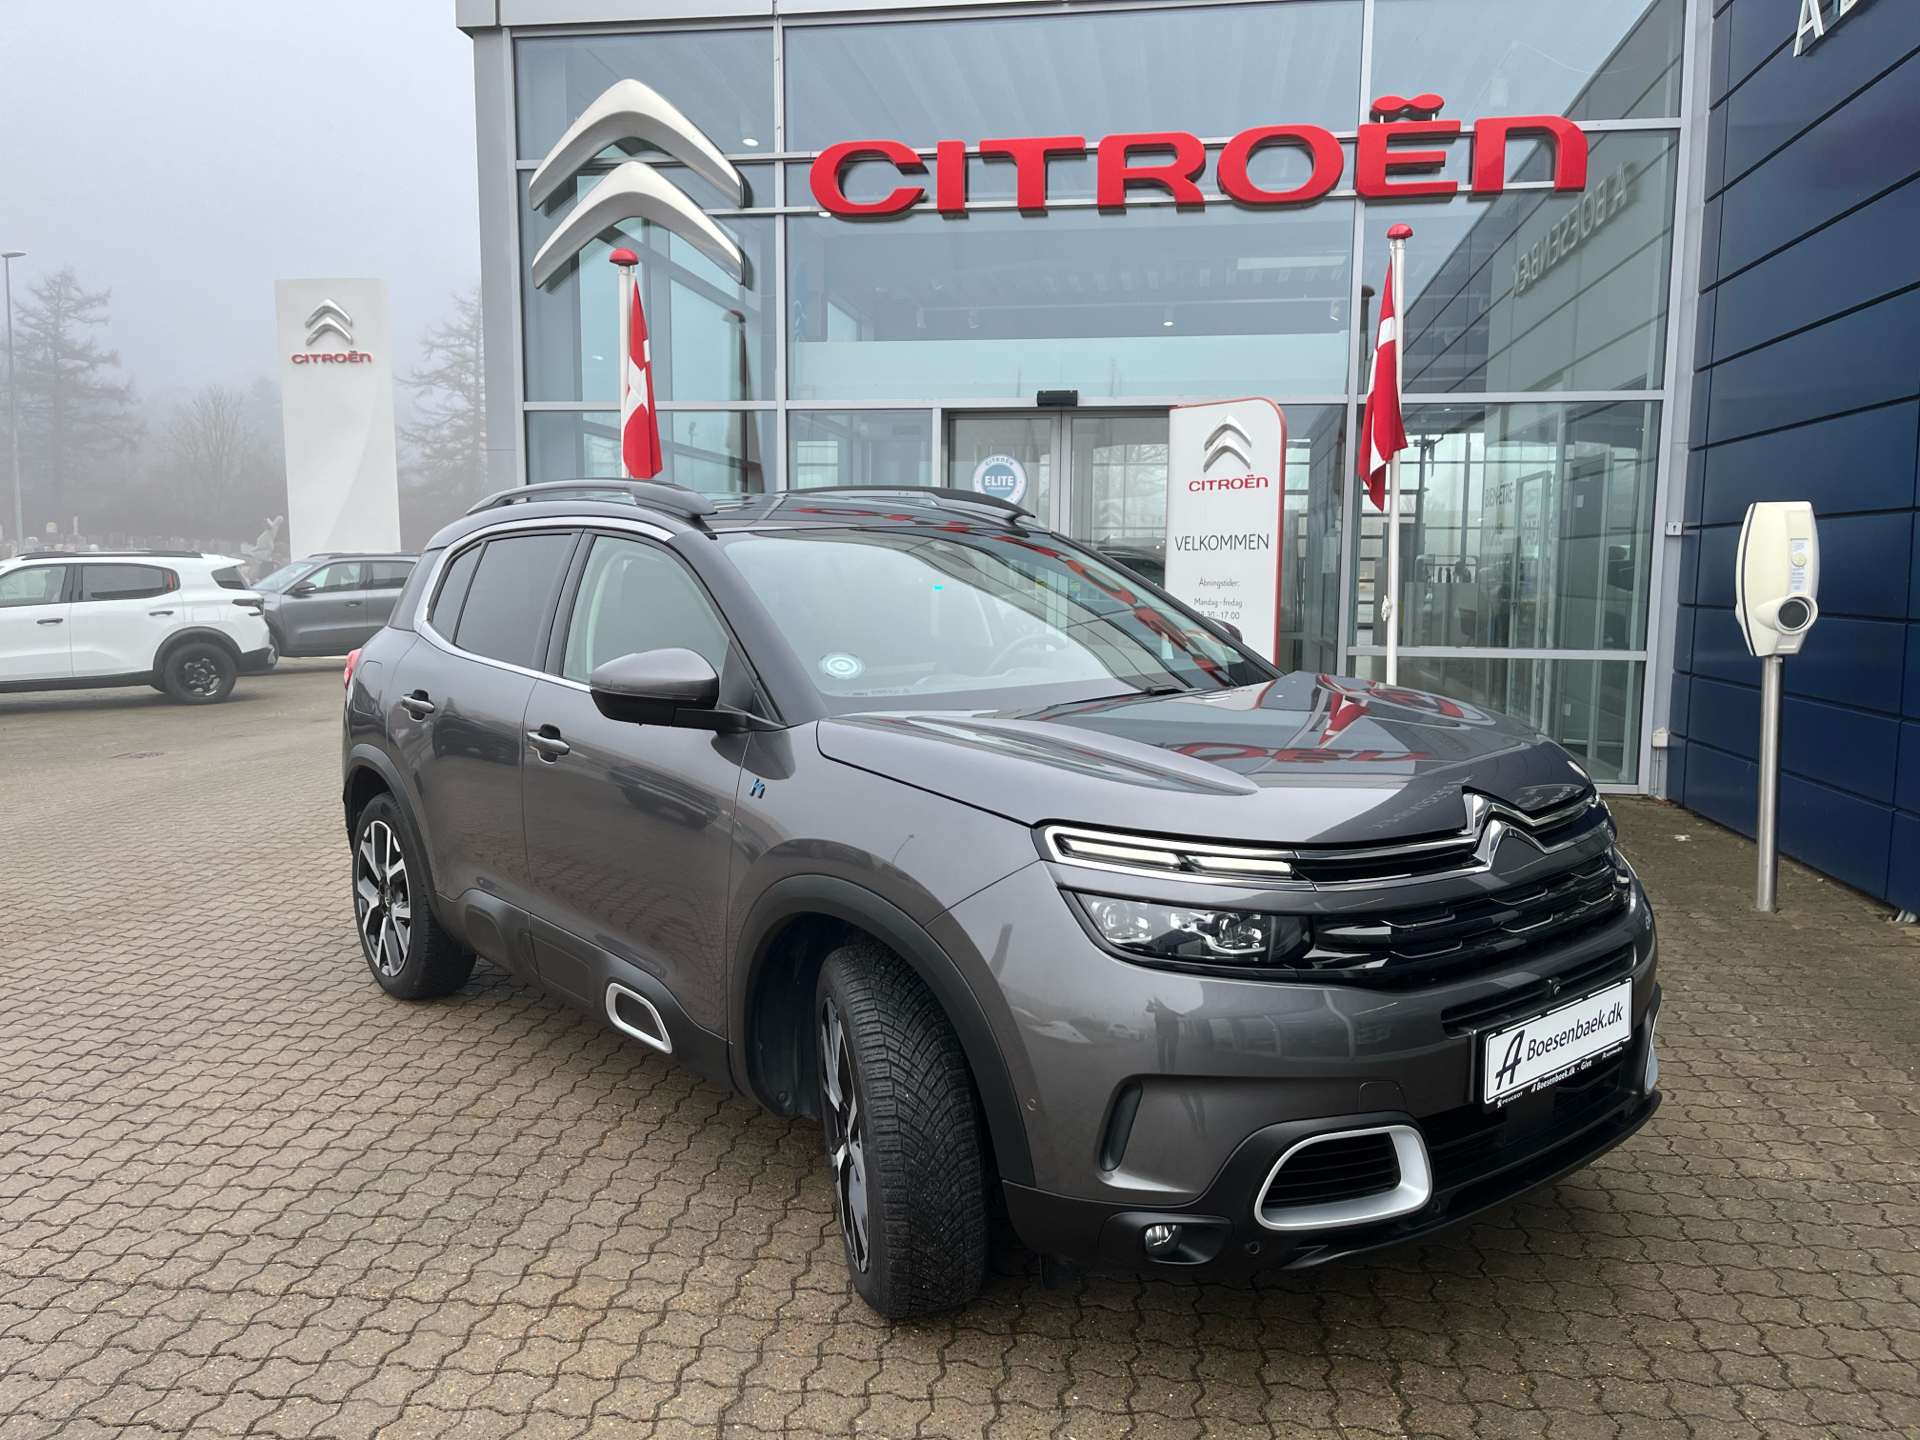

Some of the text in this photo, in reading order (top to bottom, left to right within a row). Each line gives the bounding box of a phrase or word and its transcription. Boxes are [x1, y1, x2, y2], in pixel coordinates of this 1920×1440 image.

[809, 94, 1589, 217] CITROËN
[291, 350, 372, 364] CITROËN
[984, 475, 1014, 486] ELITE
[1188, 474, 1269, 492] CITROËN
[1174, 533, 1270, 551] VELKOMMEN
[1194, 597, 1218, 608] Mandag
[1223, 598, 1243, 609] fredag
[1221, 611, 1240, 619] 17:00
[1526, 1001, 1624, 1061] Boesenbaek.dk
[1536, 1066, 1576, 1091] Boesenbaek.dk
[1580, 1060, 1593, 1070] Give
